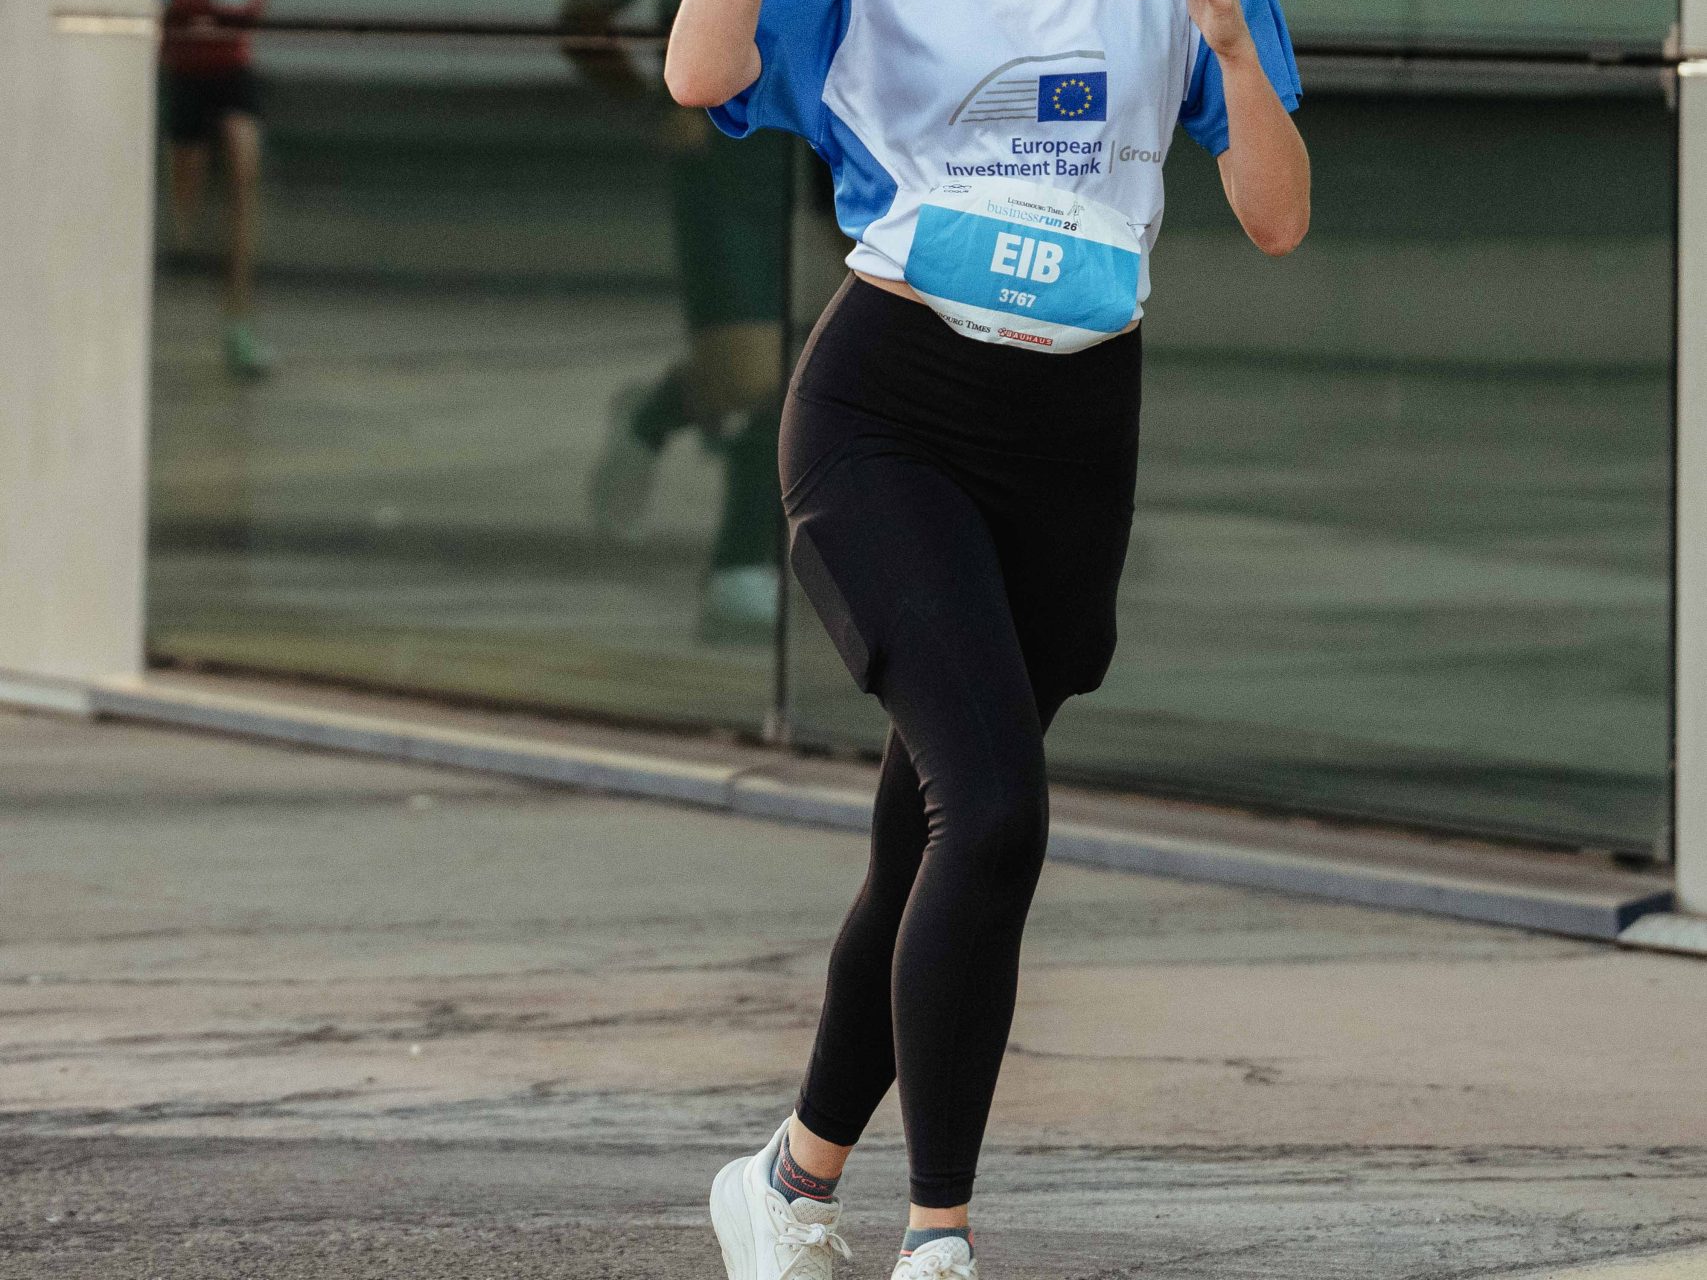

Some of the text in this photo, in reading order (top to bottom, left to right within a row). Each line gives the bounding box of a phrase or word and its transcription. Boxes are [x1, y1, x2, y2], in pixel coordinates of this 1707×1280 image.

[1012, 138, 1102, 157] European
[1119, 145, 1161, 163] Grou
[946, 158, 1102, 177] Investment Bank
[1063, 221, 1078, 231] 26
[990, 231, 1064, 284] EIB
[999, 288, 1036, 308] 3767
[965, 320, 992, 333] TIMES
[1006, 329, 1053, 345] BAUHAUS
